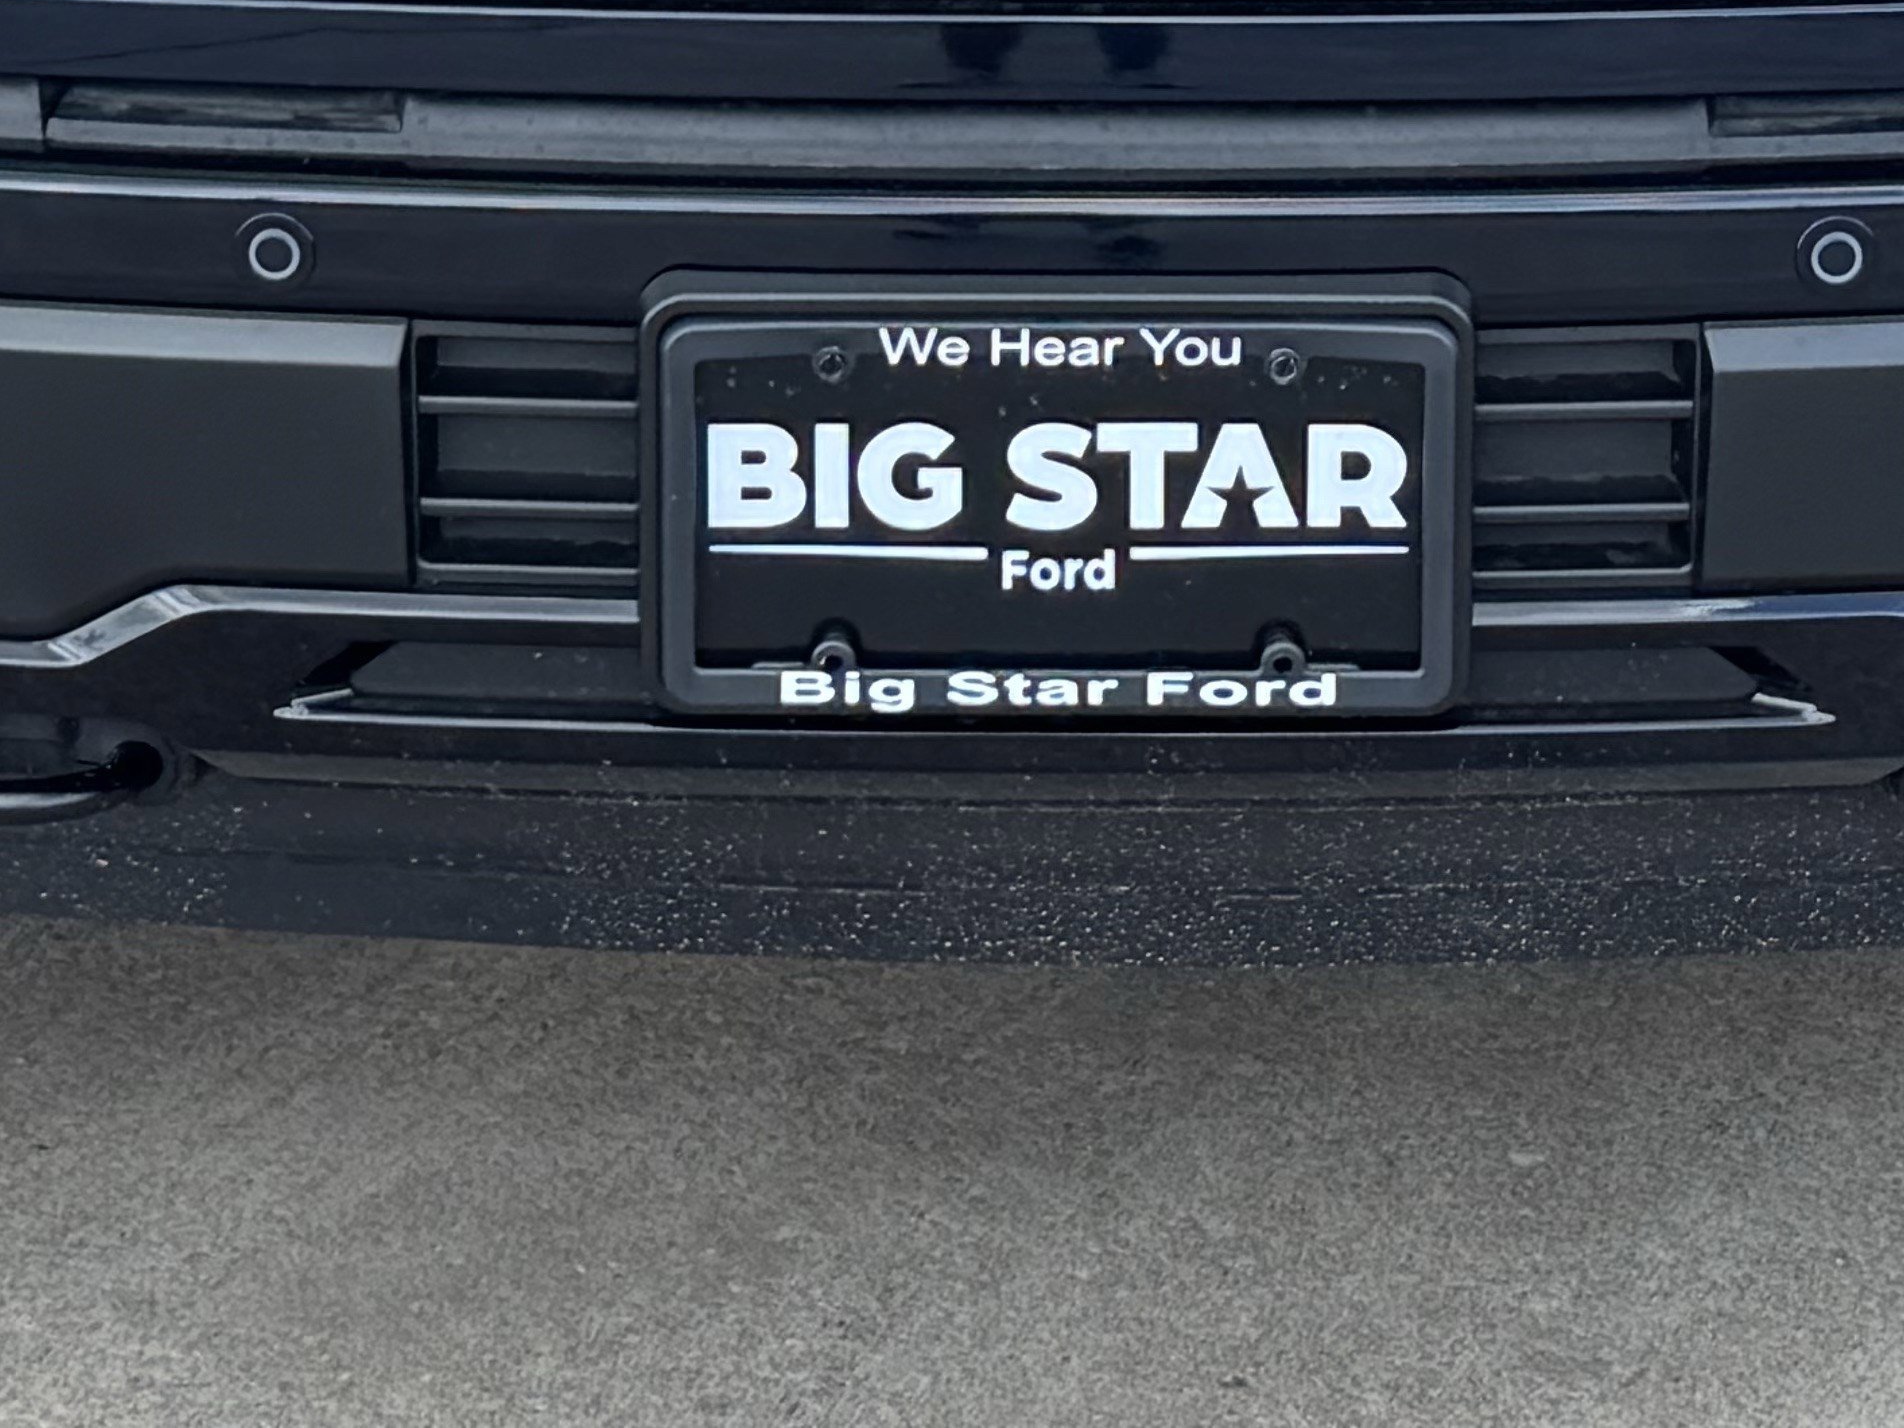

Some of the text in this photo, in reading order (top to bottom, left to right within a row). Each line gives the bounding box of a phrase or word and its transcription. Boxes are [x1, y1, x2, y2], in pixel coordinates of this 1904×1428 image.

[879, 327, 1242, 367] We Hear You
[707, 422, 1408, 531] BIG STAR
[1001, 548, 1116, 591] Ford
[780, 670, 1337, 713] Big Star Ford
